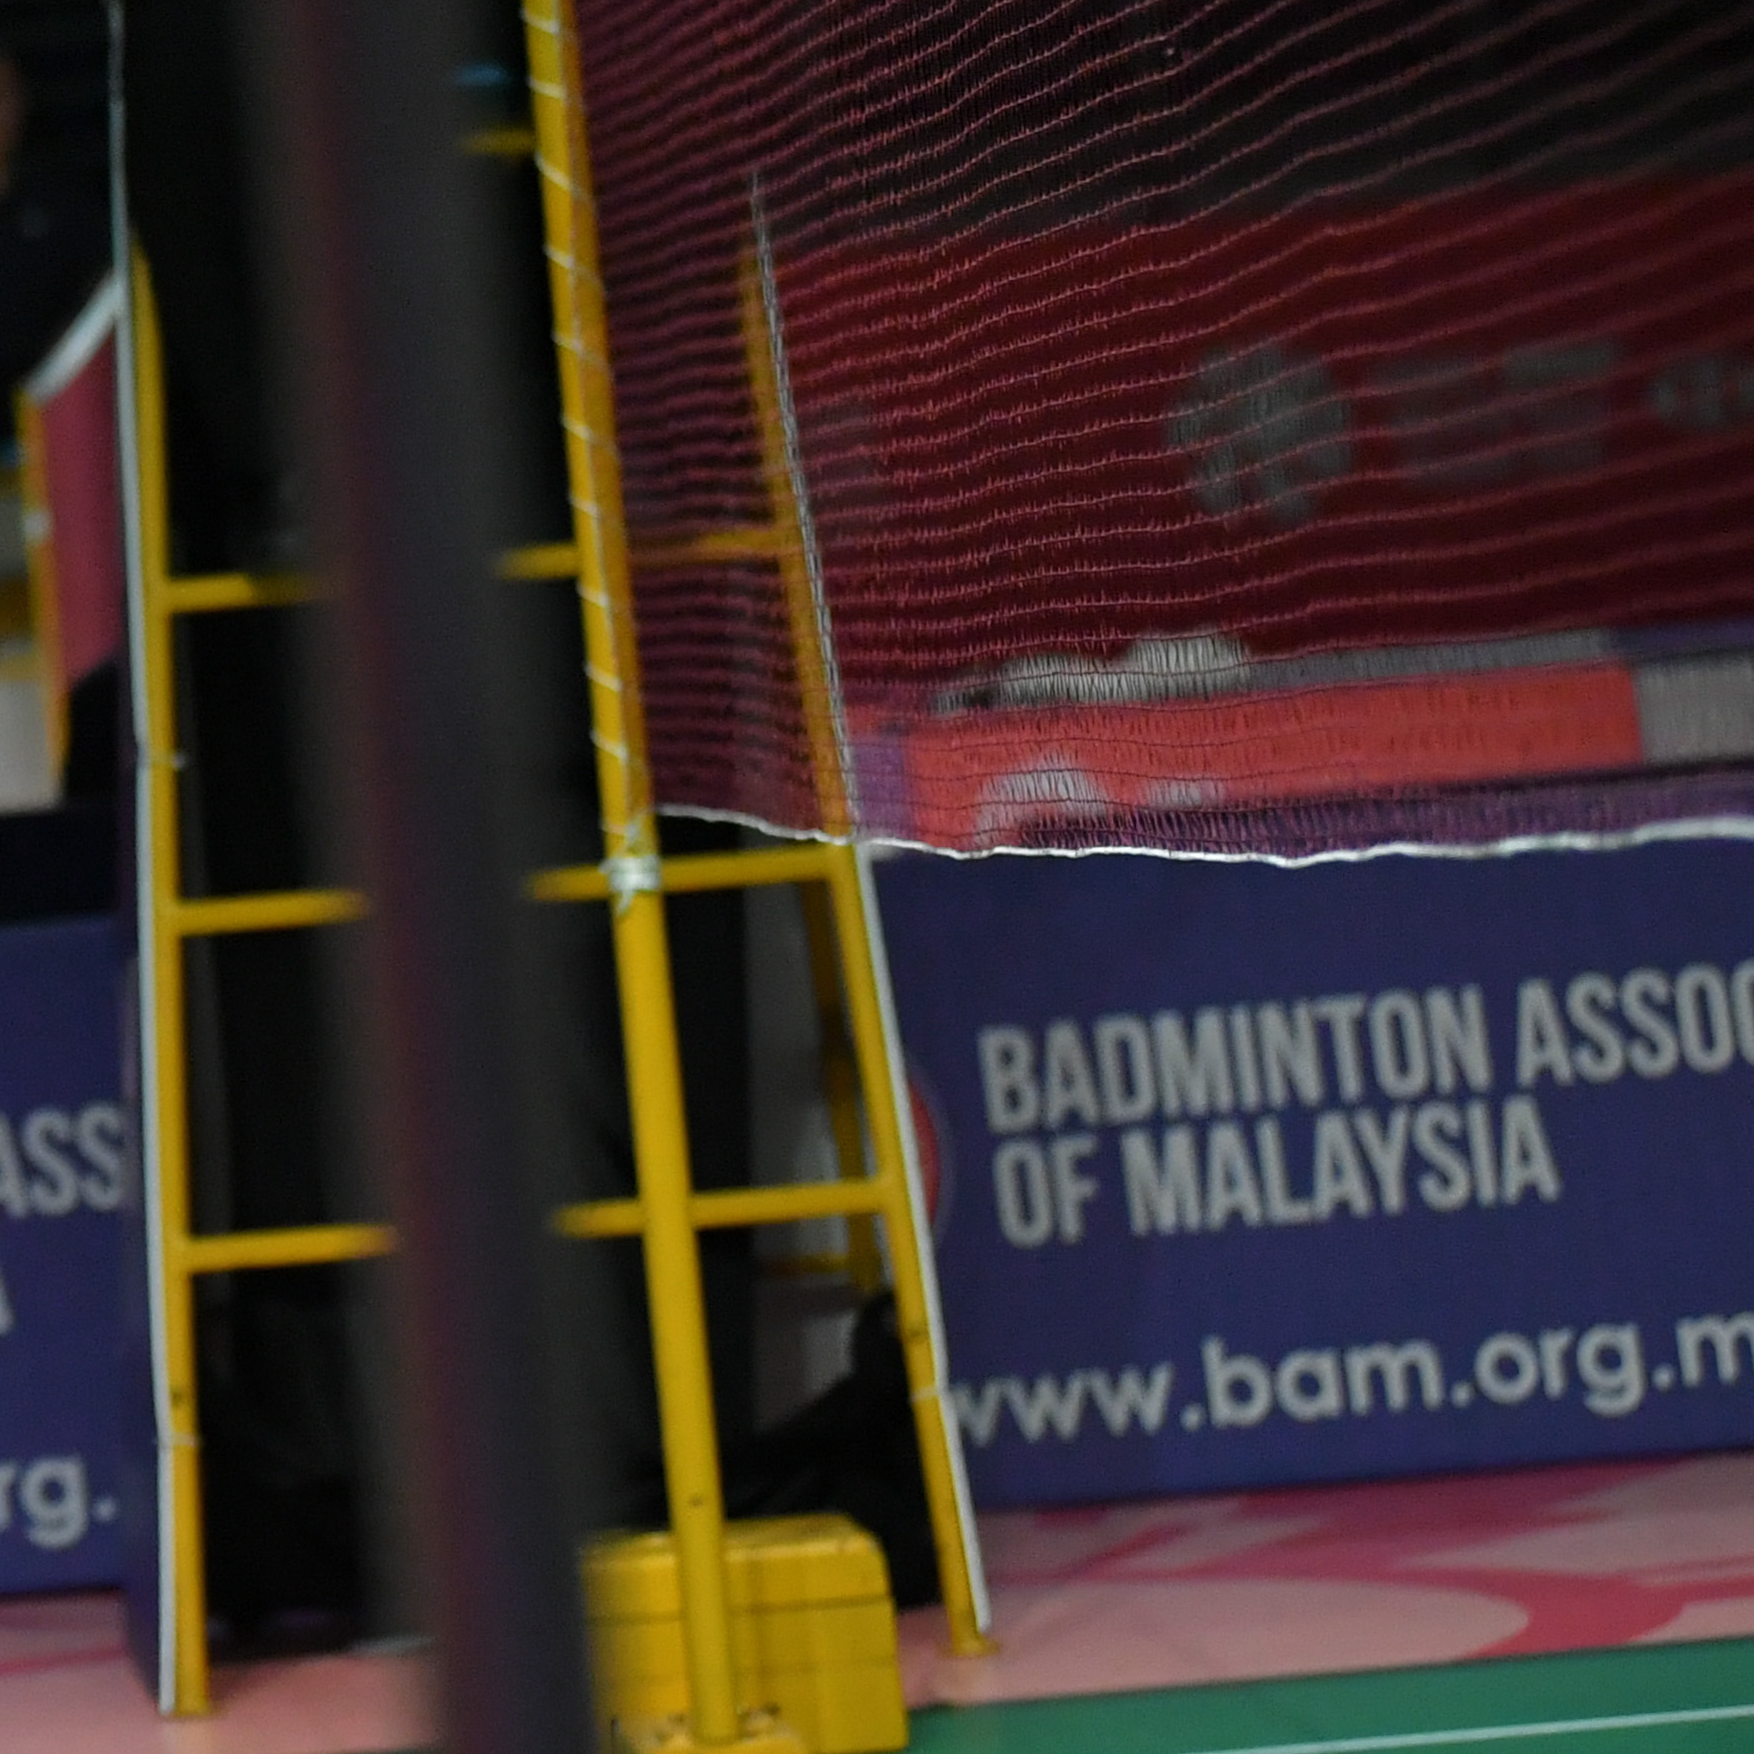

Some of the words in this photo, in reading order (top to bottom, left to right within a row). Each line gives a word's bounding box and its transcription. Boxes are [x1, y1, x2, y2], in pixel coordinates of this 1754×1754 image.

[978, 984, 1490, 1134] BADMINTON
[992, 1134, 1098, 1247] OF
[1119, 1094, 1562, 1236] MALAYSIA
